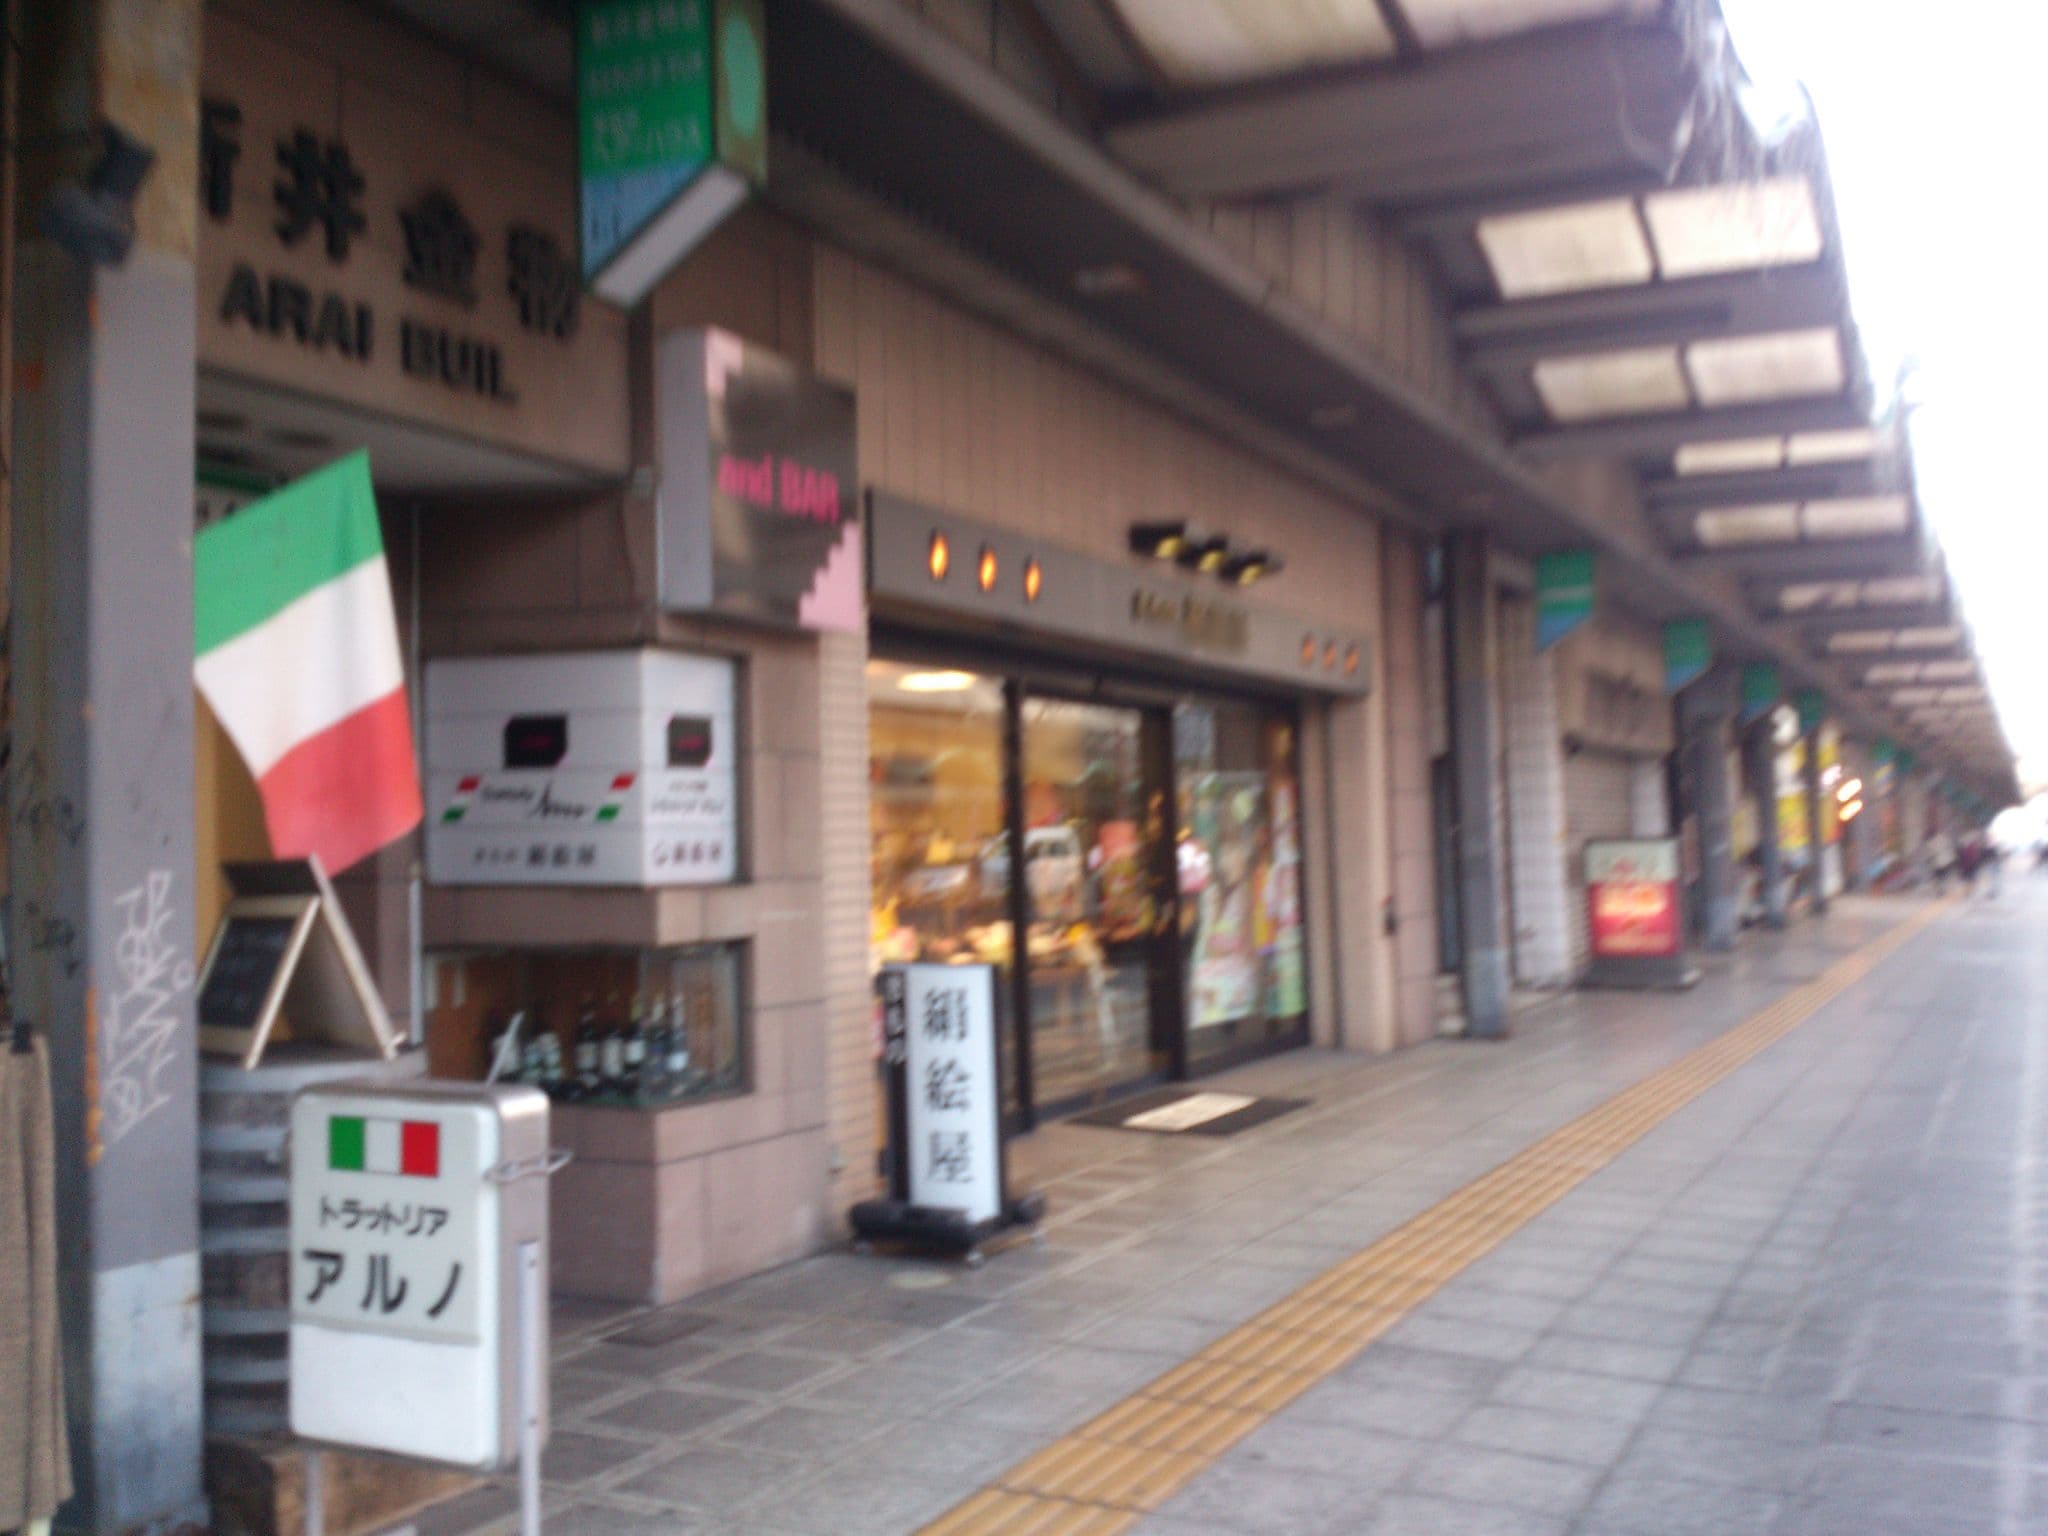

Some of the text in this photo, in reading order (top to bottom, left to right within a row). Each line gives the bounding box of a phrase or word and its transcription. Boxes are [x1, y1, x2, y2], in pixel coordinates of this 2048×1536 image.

[221, 262, 374, 364] ARAI
[320, 1195, 449, 1237] トラットリア
[303, 1248, 462, 1319] アルノ
